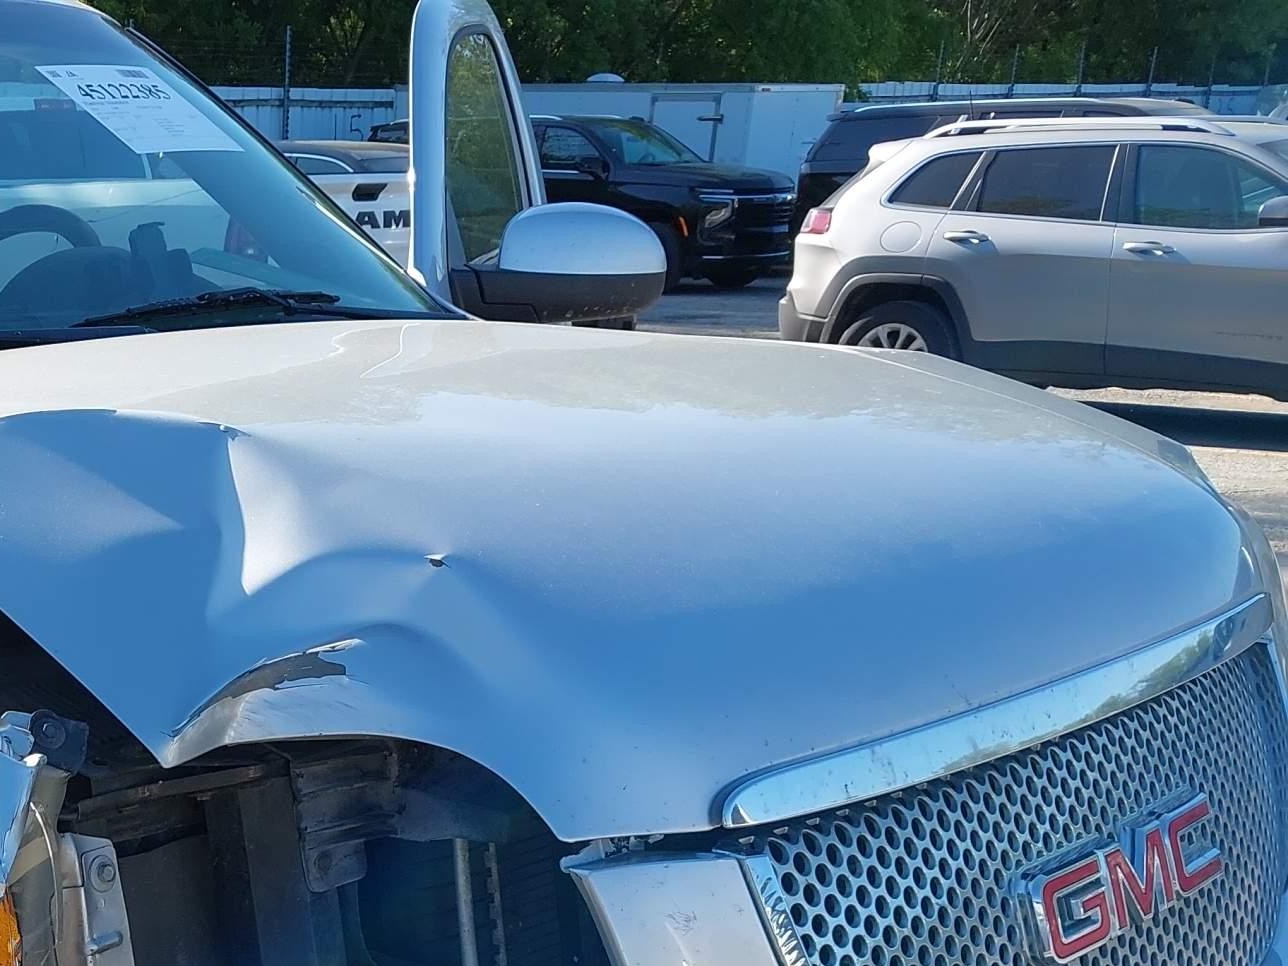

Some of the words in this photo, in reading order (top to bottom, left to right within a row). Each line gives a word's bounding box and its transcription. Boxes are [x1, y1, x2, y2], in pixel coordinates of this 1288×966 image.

[76, 83, 172, 100] 45122385
[355, 209, 411, 229] AM
[1028, 792, 1225, 964] GMC
